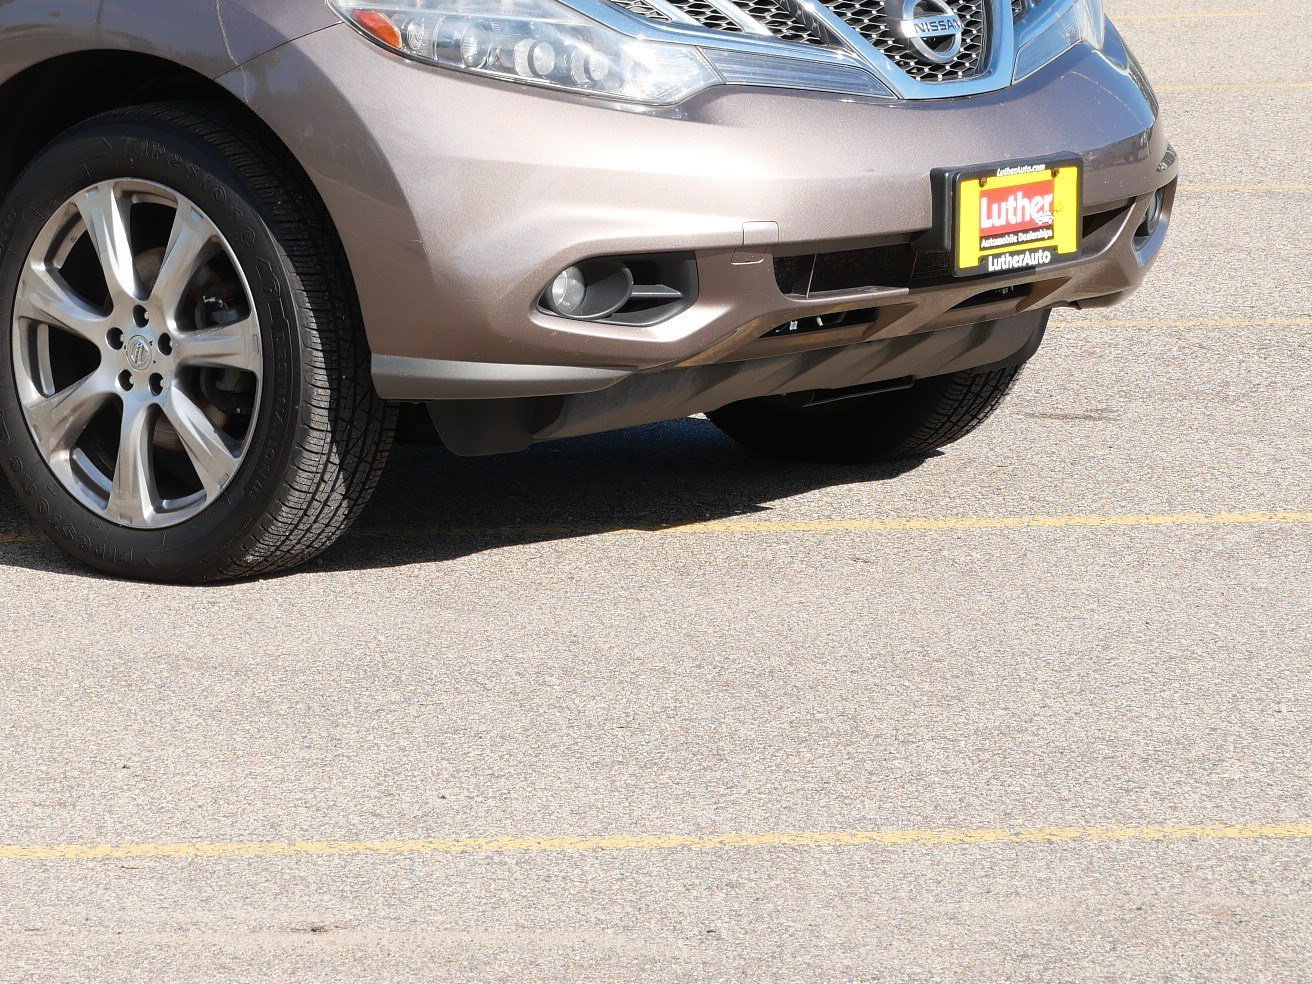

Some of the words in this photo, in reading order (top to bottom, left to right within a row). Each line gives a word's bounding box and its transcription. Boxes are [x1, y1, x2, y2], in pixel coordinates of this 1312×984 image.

[914, 19, 961, 34] NISSAN
[996, 163, 1046, 177] LutherAuto.com
[980, 190, 1054, 229] Luther
[981, 234, 1017, 248] Automobile
[1018, 228, 1053, 244] Dealerships
[988, 249, 1051, 272] LutherAuto
